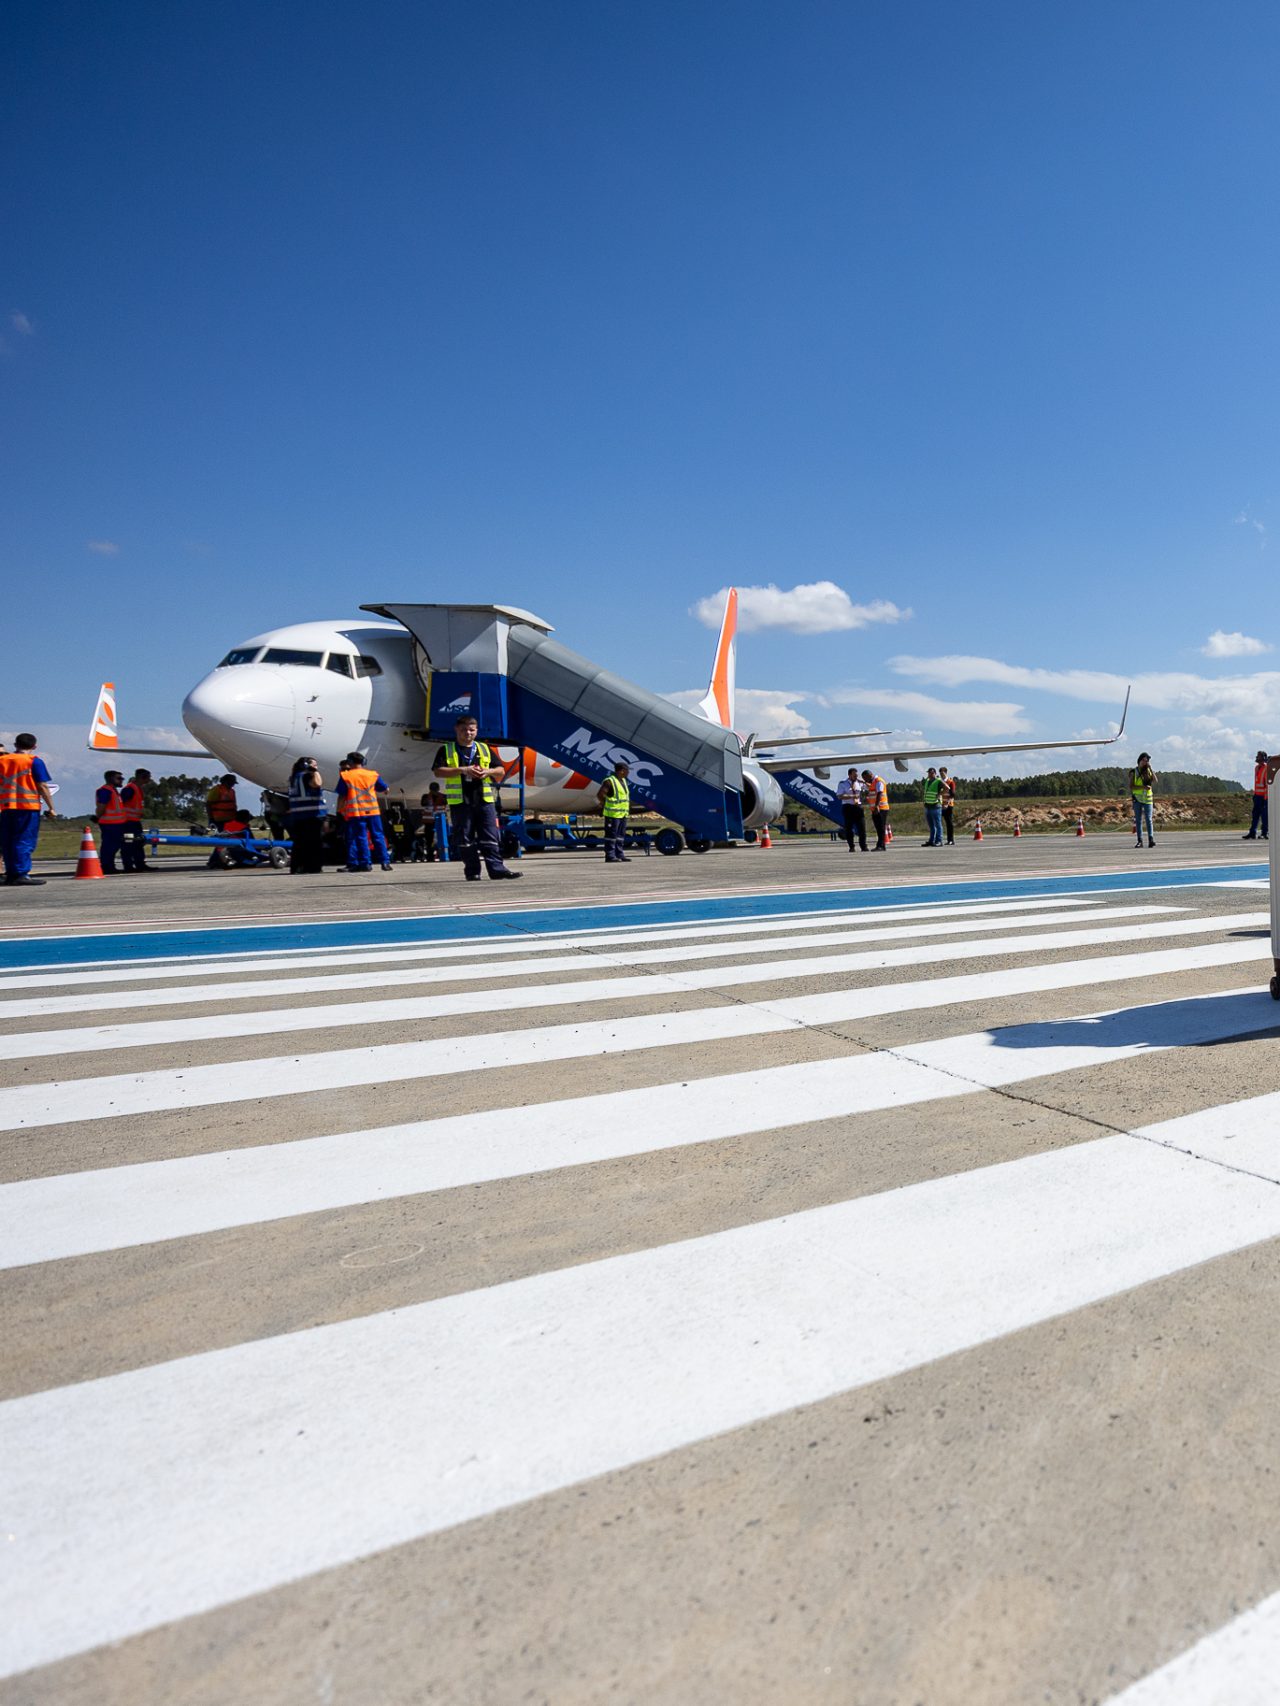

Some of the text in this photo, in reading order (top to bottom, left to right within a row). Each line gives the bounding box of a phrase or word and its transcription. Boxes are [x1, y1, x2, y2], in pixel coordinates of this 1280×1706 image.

[552, 743, 602, 771] AIRPORT
[605, 770, 657, 800] SVICES
[561, 726, 664, 787] MSC
[790, 776, 835, 806] MSC
